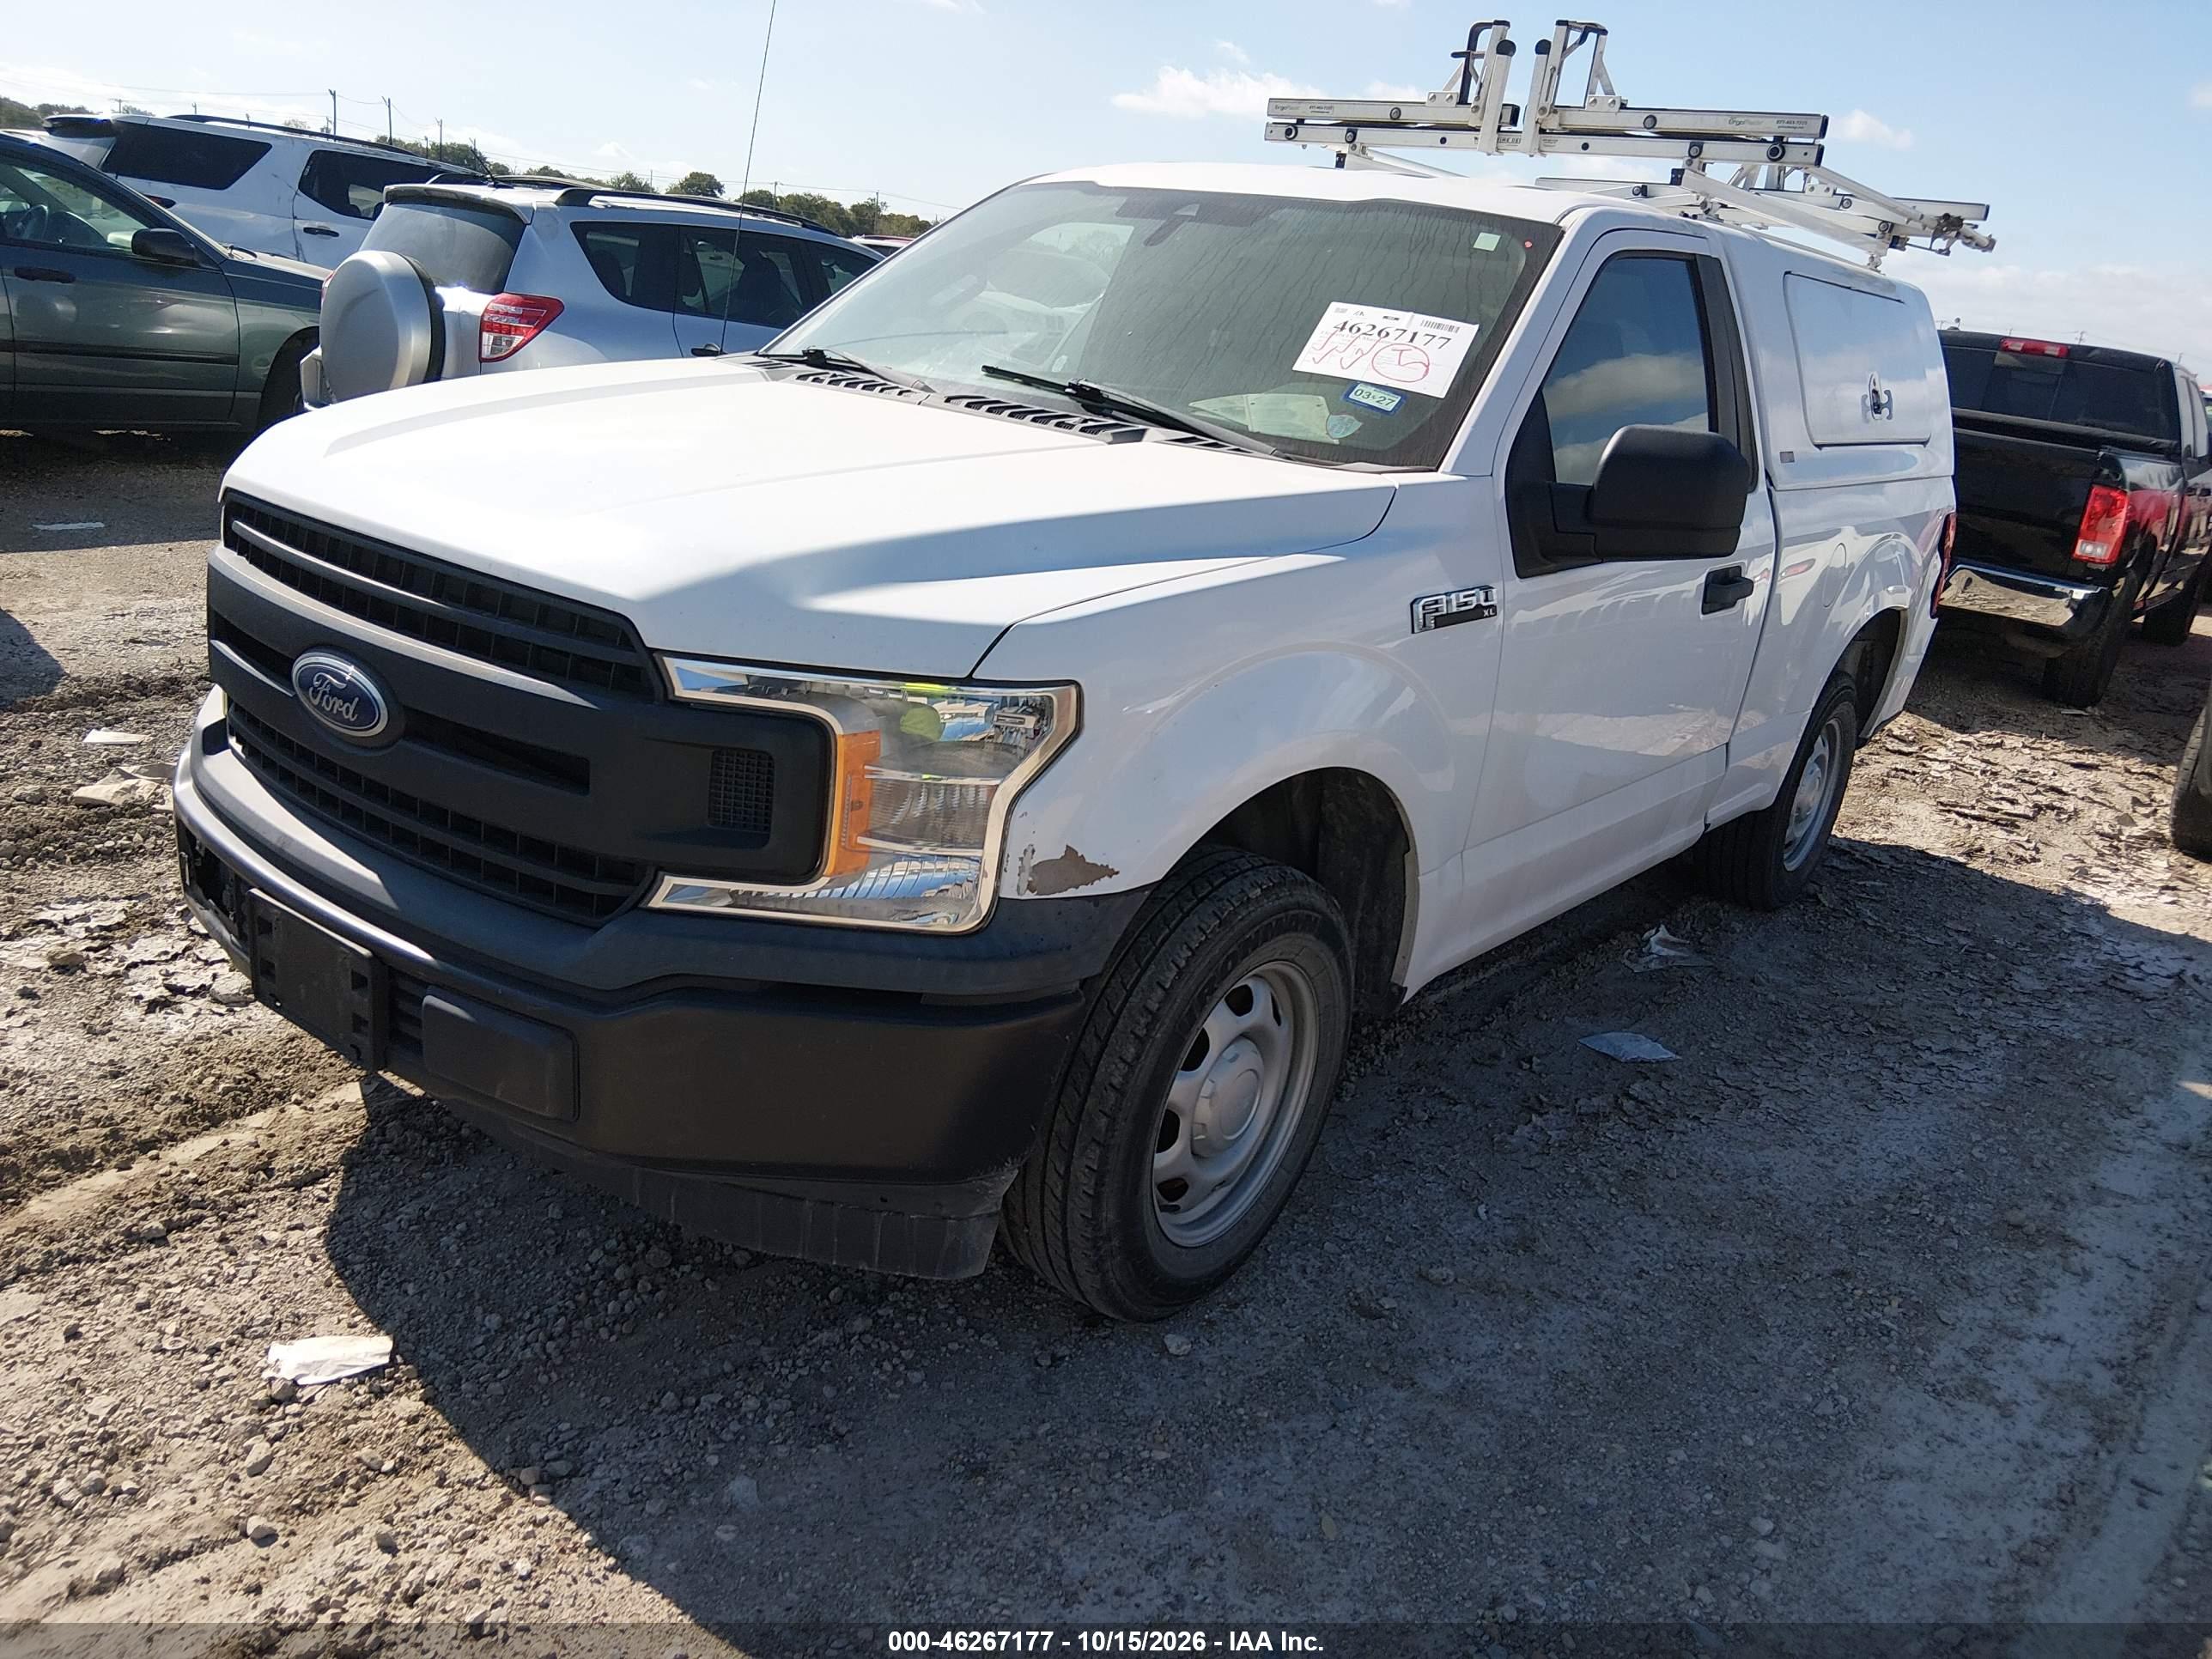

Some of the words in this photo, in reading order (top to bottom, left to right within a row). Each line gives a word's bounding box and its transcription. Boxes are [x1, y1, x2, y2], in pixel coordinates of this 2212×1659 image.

[1333, 320, 1452, 349] 46267177
[1353, 389, 1371, 399] 03
[1376, 396, 1396, 406] 27
[1483, 608, 1496, 617] XL
[308, 672, 361, 722] Ford
